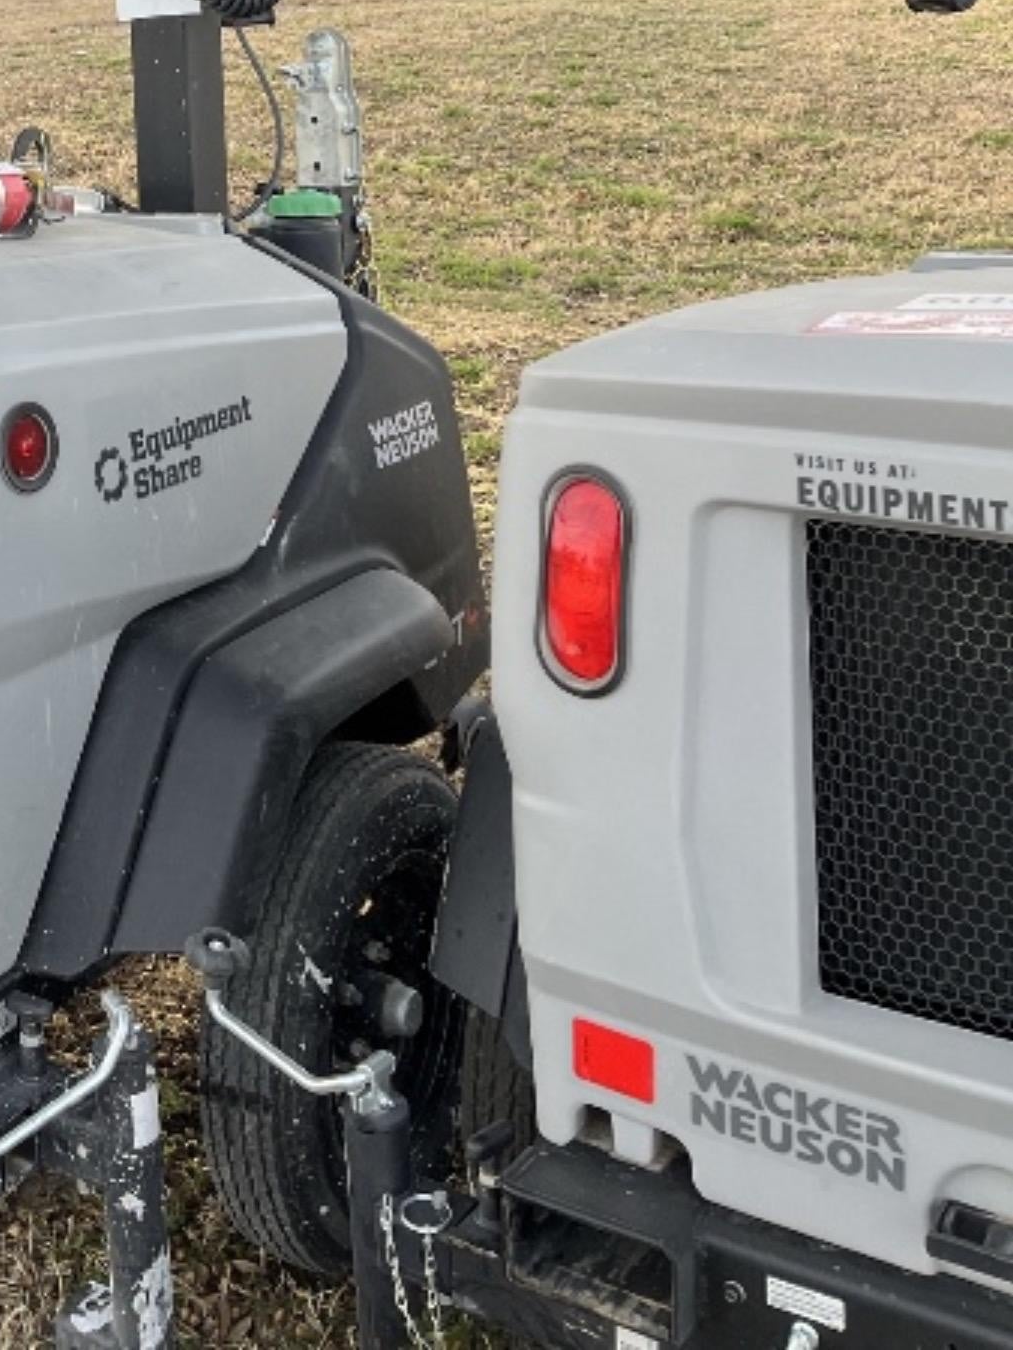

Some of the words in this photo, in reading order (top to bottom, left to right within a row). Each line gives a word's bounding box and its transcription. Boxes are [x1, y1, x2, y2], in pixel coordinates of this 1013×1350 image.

[128, 395, 252, 462] Equipment
[367, 400, 436, 445] WACKER
[373, 422, 441, 469] NEUSON
[133, 453, 202, 500] Share
[794, 452, 844, 472] VISIT
[853, 460, 877, 476] US
[685, 1052, 905, 1155] WACKER
[690, 1090, 906, 1192] NEUSON
